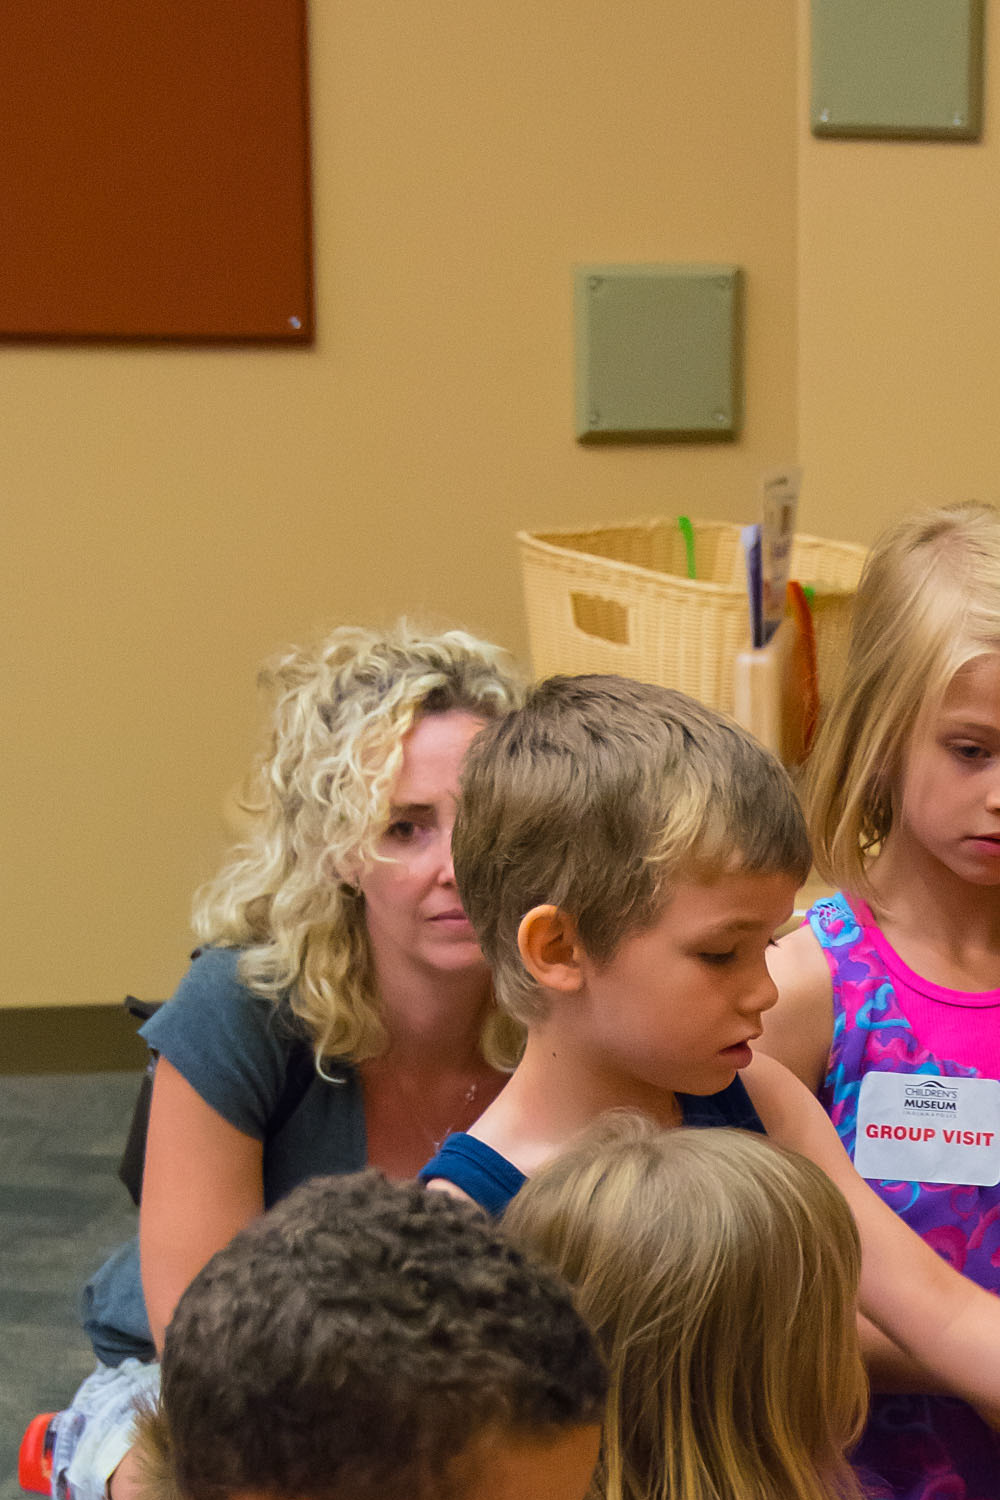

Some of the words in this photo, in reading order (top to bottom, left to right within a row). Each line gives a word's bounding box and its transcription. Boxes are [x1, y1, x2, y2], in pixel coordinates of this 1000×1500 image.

[904, 1087, 958, 1099] CHILDREN'S
[904, 1099, 957, 1111] MUSEUM
[865, 1124, 936, 1142] GROUP
[942, 1129, 995, 1146] VISIT
